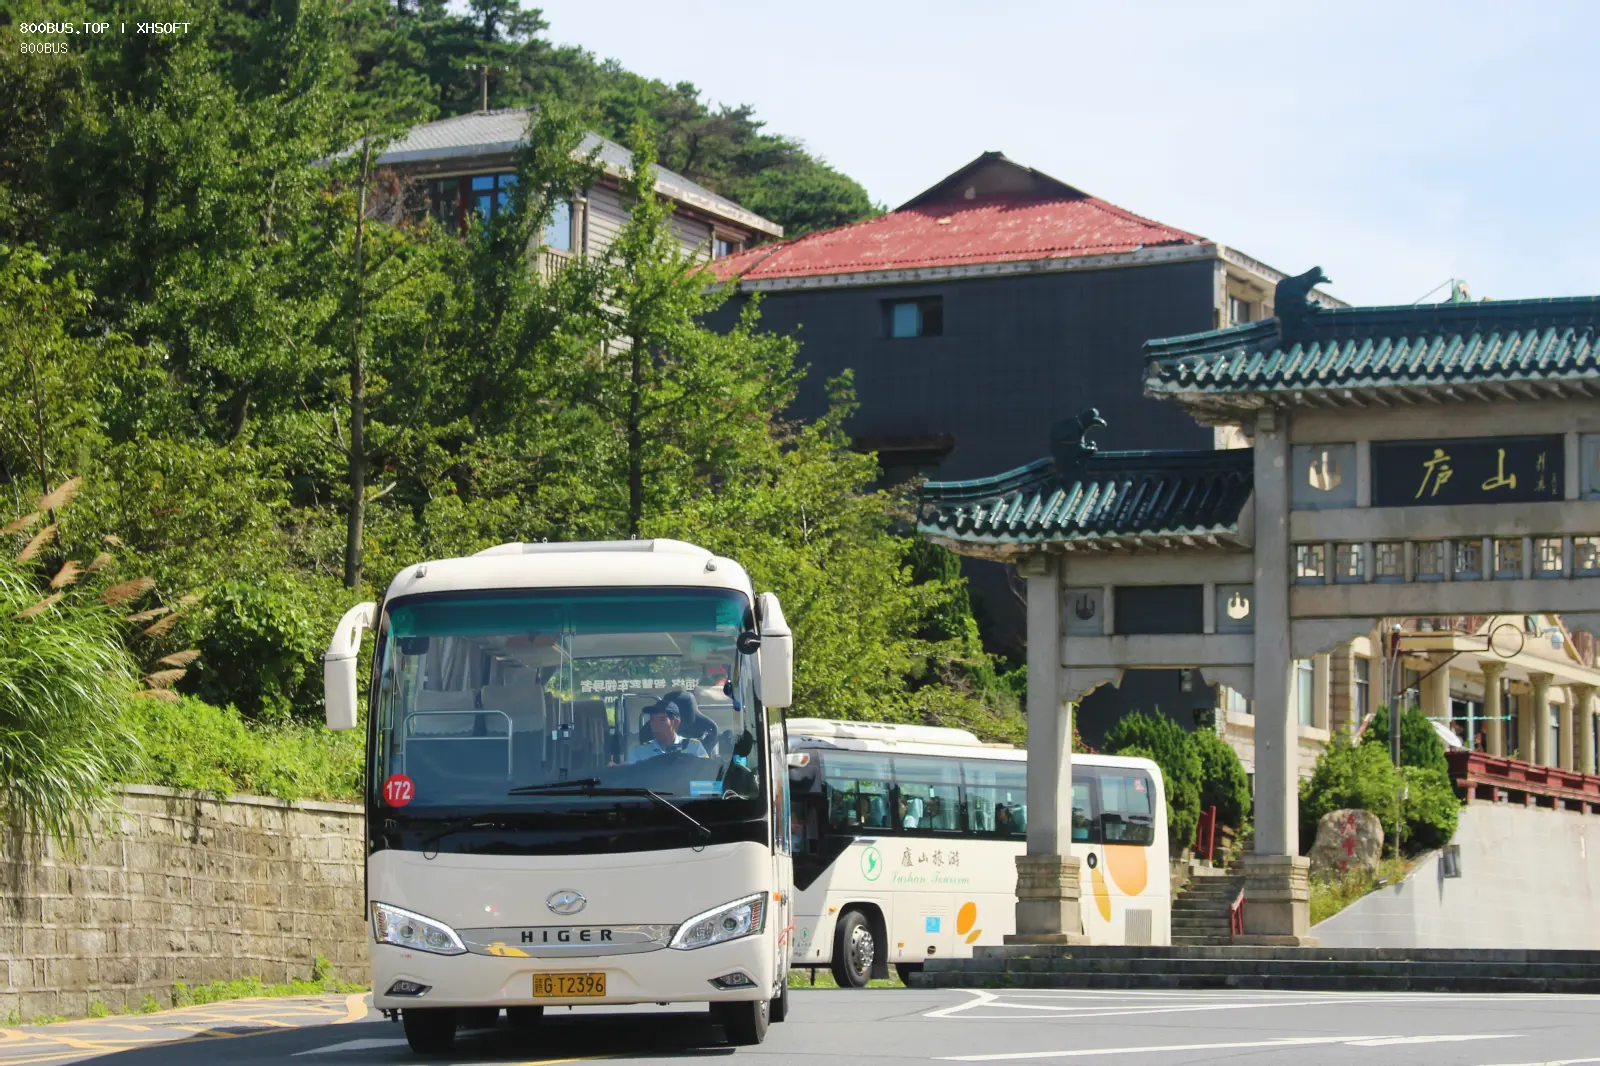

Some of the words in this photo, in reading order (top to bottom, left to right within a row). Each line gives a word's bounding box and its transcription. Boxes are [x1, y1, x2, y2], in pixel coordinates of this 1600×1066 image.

[1414, 448, 1517, 499] 庐山
[386, 781, 411, 800] 172
[521, 928, 613, 944] HIGER
